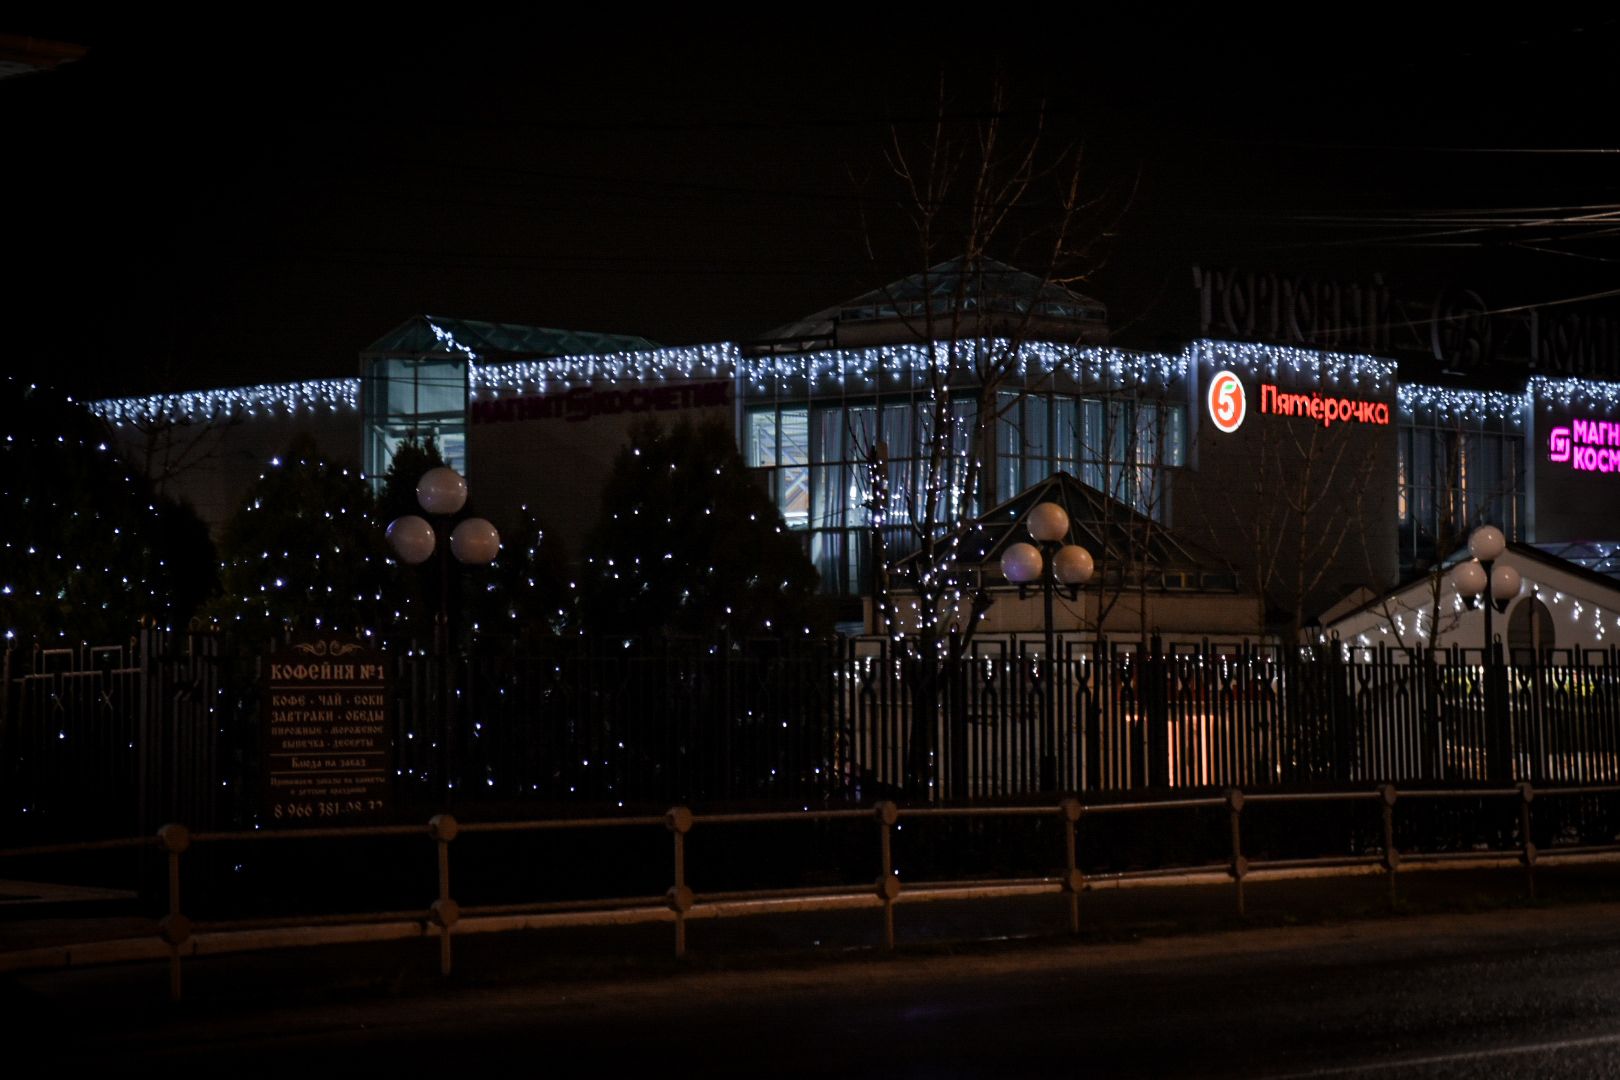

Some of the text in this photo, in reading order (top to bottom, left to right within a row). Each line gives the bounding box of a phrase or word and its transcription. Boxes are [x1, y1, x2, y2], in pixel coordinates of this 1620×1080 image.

[1261, 384, 1390, 428] Пятёрочка
[271, 662, 355, 680] КОФЕЙНЯ
[272, 692, 384, 707] КОФЕ ЧАЙ СОКИ
[271, 710, 385, 723] ЗАВТРАКИ ОБЕДЫ
